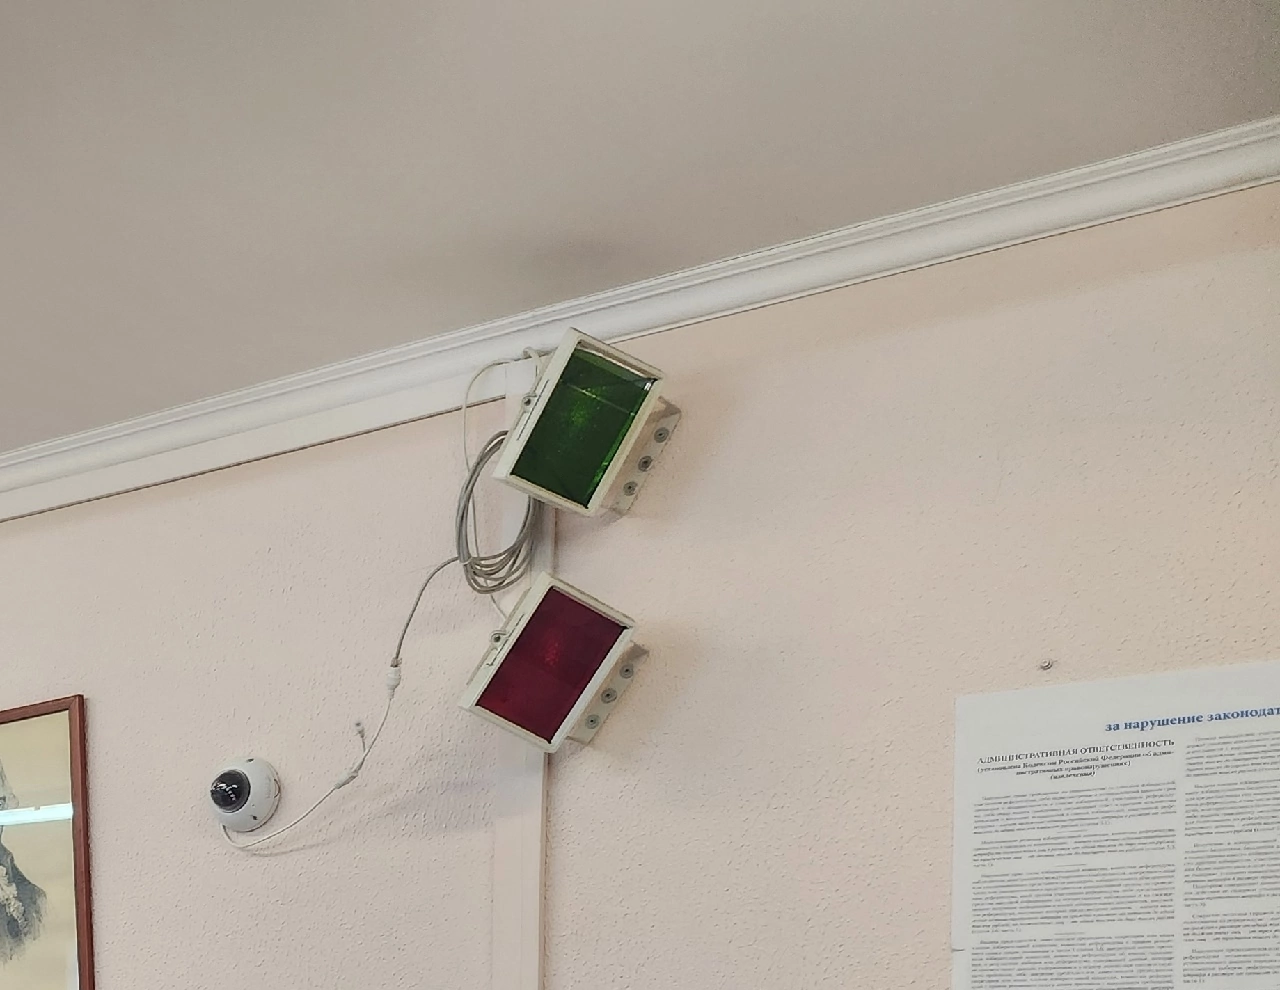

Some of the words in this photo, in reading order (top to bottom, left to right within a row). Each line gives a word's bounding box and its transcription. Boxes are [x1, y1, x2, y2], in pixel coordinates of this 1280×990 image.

[1105, 722, 1120, 732] за
[1124, 714, 1204, 731] нарушение
[977, 748, 1078, 764] АДМИНИСТРАТИВНАЯ
[1080, 739, 1175, 755] ОТВЕТСТВЕННОСТЬ
